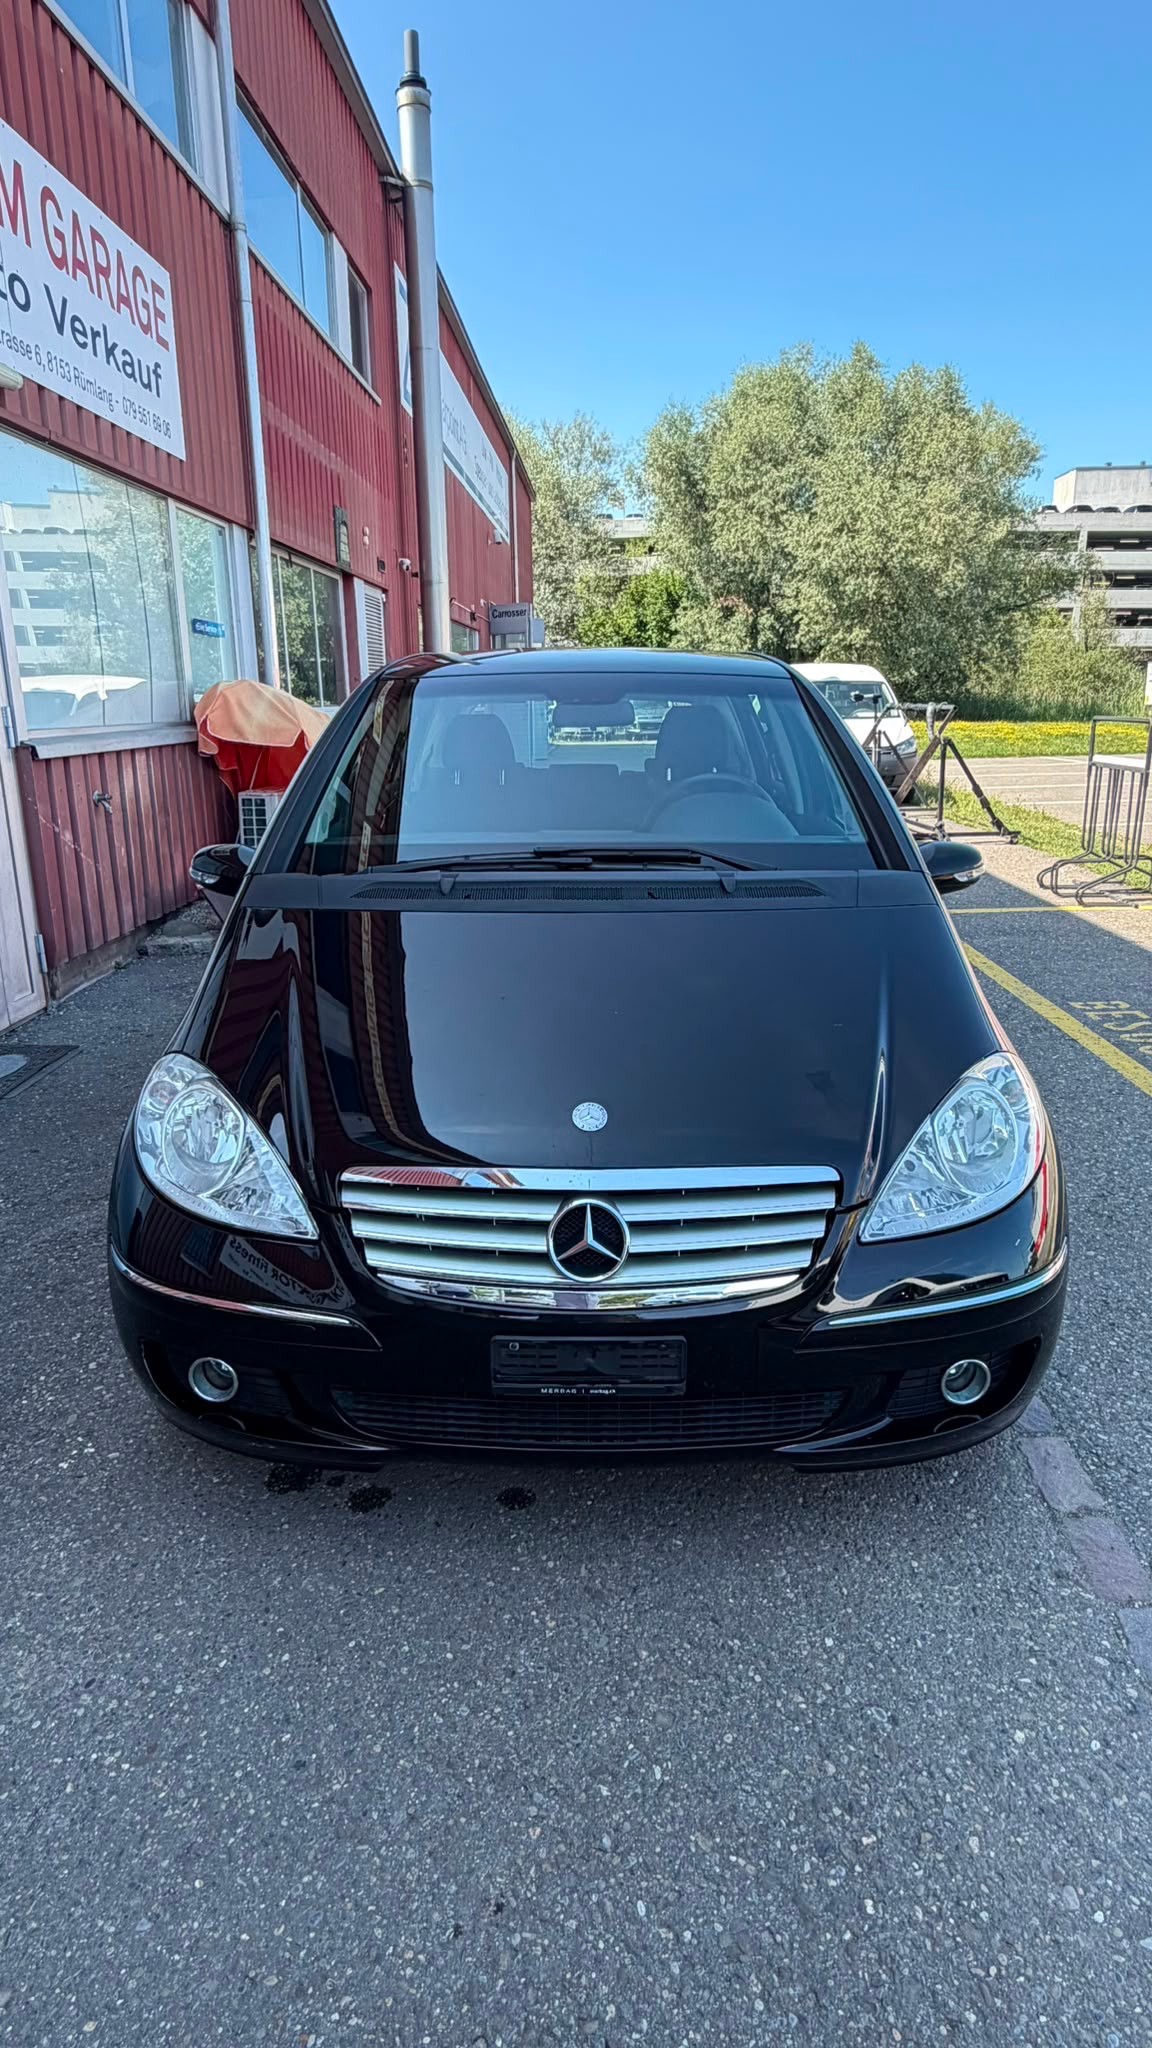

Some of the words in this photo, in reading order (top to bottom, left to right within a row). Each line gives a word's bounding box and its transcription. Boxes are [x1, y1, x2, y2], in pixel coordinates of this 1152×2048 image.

[40, 185, 170, 352] GARAGE
[0, 328, 32, 361] rasse
[34, 344, 46, 373] 6,
[46, 351, 71, 383] 8153
[73, 366, 114, 413] Rümlang
[122, 396, 137, 420] 079
[138, 404, 151, 428] 551
[44, 282, 162, 398] Verkauf
[492, 608, 527, 619] Carrosser
